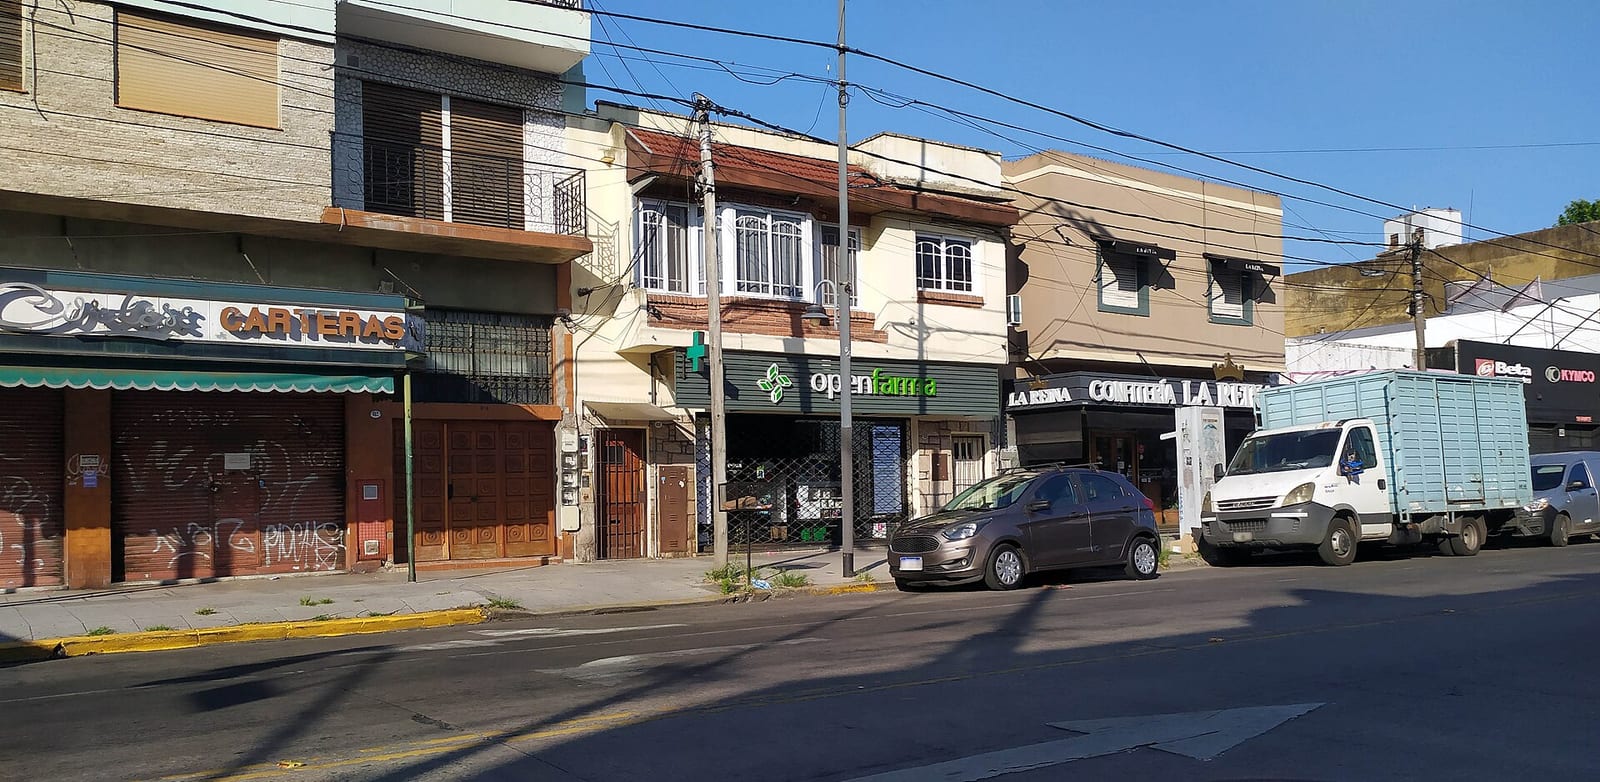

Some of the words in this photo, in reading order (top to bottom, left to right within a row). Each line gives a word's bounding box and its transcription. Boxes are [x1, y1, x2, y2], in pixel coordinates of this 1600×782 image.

[220, 307, 405, 340] CARTERAS
[1495, 362, 1531, 376] Beta
[1561, 369, 1595, 382] KYMCO
[1007, 391, 1029, 406] LA
[1029, 387, 1073, 405] REINA
[1088, 378, 1177, 405] CONFITERÍA
[1180, 379, 1215, 406] LA
[1215, 381, 1270, 409] REIN
